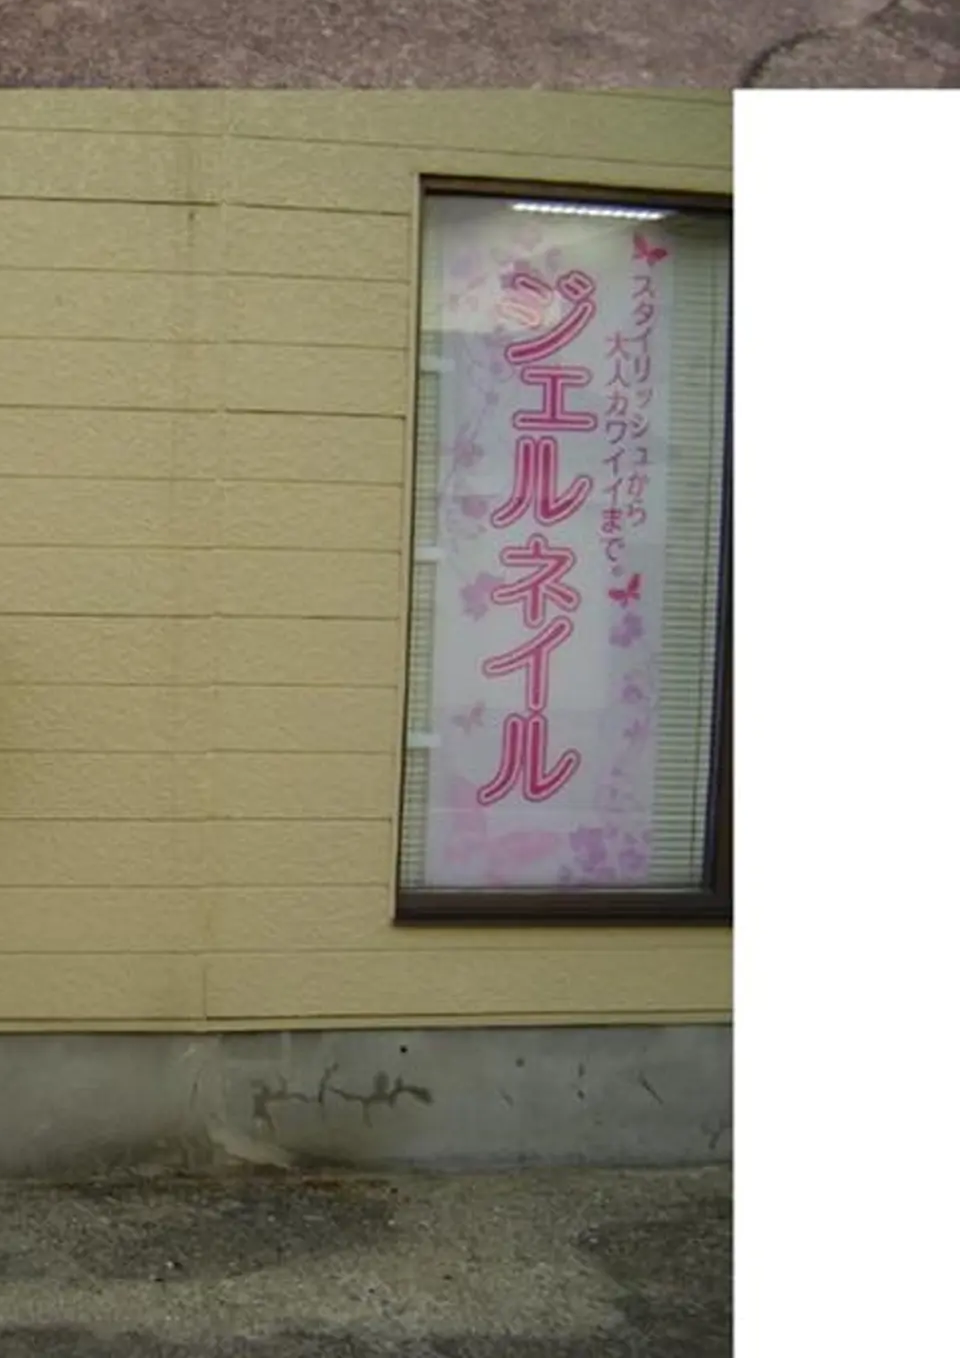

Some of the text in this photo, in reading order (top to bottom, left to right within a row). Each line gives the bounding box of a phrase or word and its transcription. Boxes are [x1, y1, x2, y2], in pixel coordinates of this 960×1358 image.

[476, 271, 600, 806] ジェルネイル
